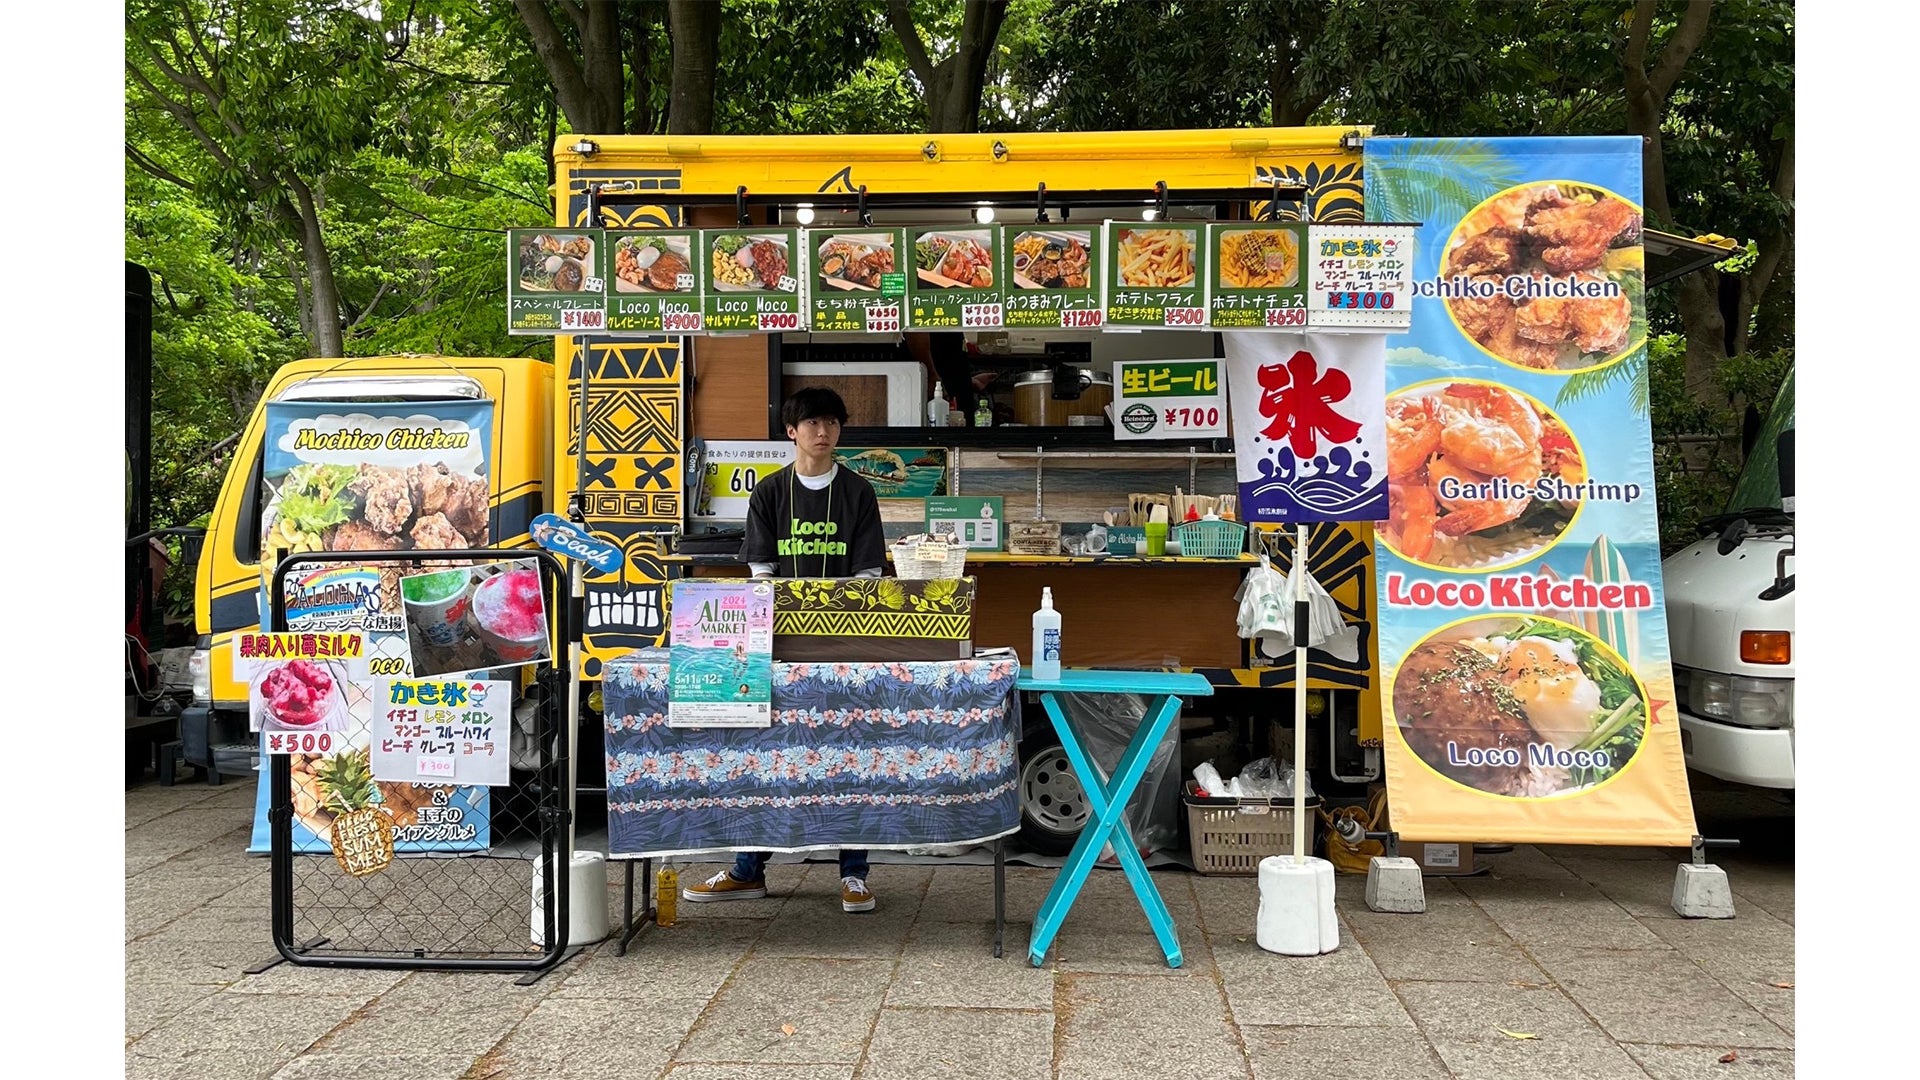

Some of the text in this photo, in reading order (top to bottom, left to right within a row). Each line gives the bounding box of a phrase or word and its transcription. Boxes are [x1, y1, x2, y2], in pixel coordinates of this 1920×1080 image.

[1320, 239, 1382, 257] かき氷
[1319, 260, 1404, 269] イチゴ レモン メロン
[1325, 271, 1354, 280] マンゴー
[1379, 282, 1405, 291] コーラ
[619, 299, 689, 314] Loco Moco
[717, 296, 788, 312] Loco Moco
[815, 298, 899, 309] もち粉チキン
[1328, 292, 1394, 309] ¥300
[564, 311, 602, 326] ¥1400
[664, 313, 700, 329] ¥900
[705, 315, 758, 327] サルサソース
[760, 313, 798, 328] ¥900
[868, 308, 898, 317] ¥650
[1062, 310, 1101, 327] ¥1200
[1166, 308, 1204, 325] ¥500
[1266, 309, 1305, 326] ¥650
[816, 321, 860, 330] ライス付き
[868, 321, 898, 330] ¥850
[914, 317, 959, 326] ライス付き
[1123, 367, 1217, 394] 生ビール
[1257, 350, 1363, 459] 氷
[1165, 407, 1219, 427] ¥700
[294, 427, 470, 450] Mochico Chicken
[730, 468, 756, 493] 60
[1439, 478, 1641, 502] Garlic-Shrimp
[791, 518, 838, 535] Loco
[553, 526, 613, 564] Beach
[777, 539, 847, 555] Kitchen
[298, 582, 367, 608] ALOHA
[1387, 575, 1652, 608] Loco Kitchen
[701, 623, 746, 634] MARKET
[240, 634, 362, 659] 果肉入り苺ミルク
[390, 682, 467, 706] かき氷
[387, 709, 493, 725] イチゴ レモン メロン
[394, 725, 492, 740] マンゴー ブルーハワイ
[269, 733, 332, 752] ¥500
[382, 739, 413, 752] ピーチ
[463, 742, 495, 756] コーラ
[1447, 742, 1611, 768] Loco Moco
[434, 791, 448, 805] &
[342, 831, 381, 856] SUM
[346, 848, 388, 873] MER
